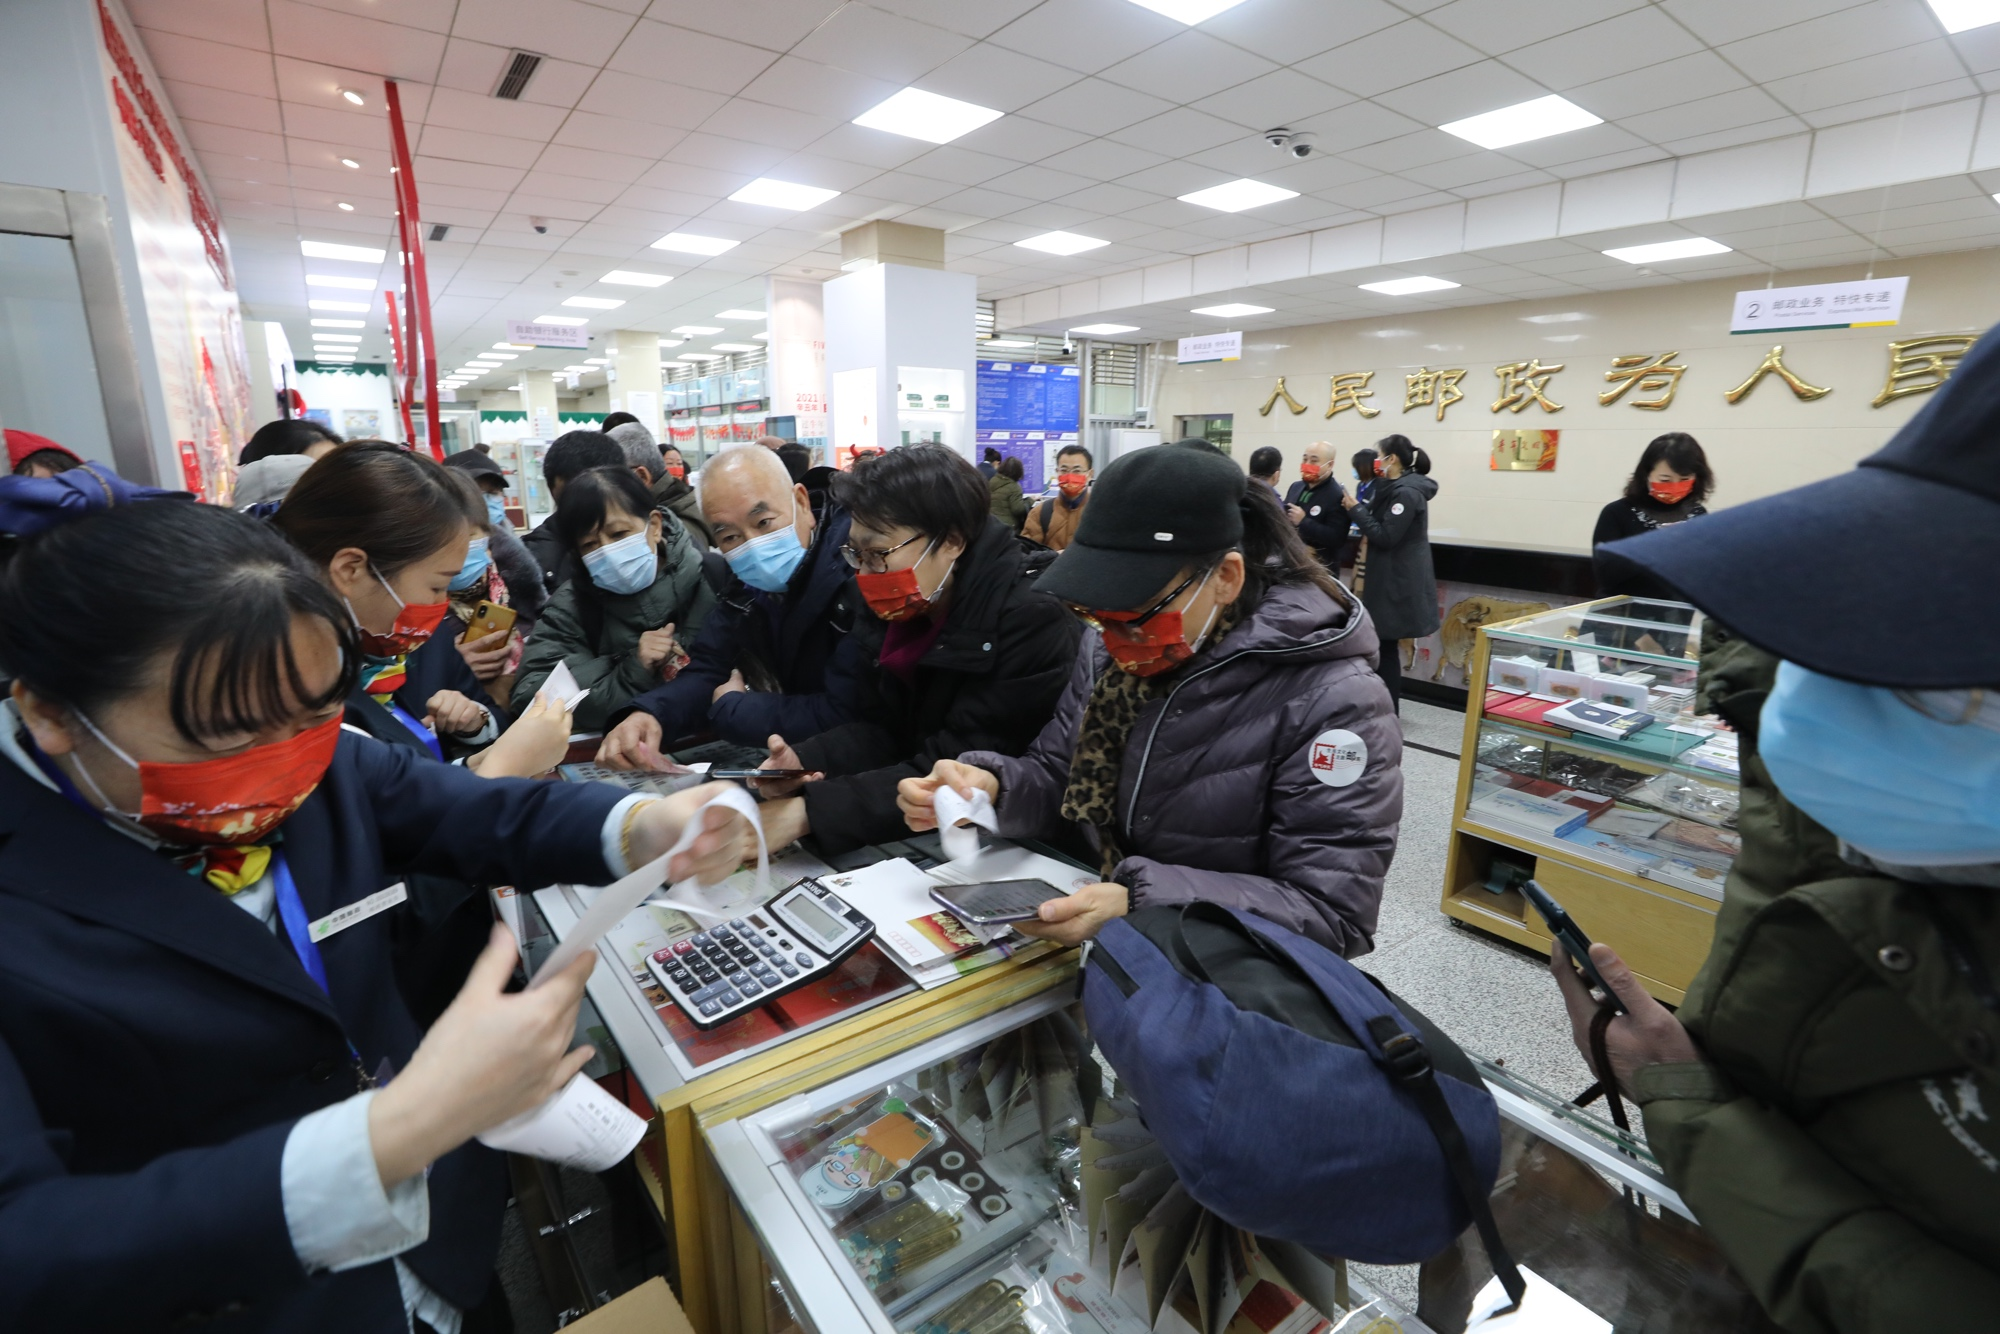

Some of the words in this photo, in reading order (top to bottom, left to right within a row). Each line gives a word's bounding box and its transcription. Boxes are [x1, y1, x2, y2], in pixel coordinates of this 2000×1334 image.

[1746, 303, 1761, 319] 2
[1772, 296, 1825, 310] 邮政业务
[1833, 291, 1891, 305] 特快专递
[515, 325, 578, 337] 自助银行服务区
[796, 393, 819, 403] 2021
